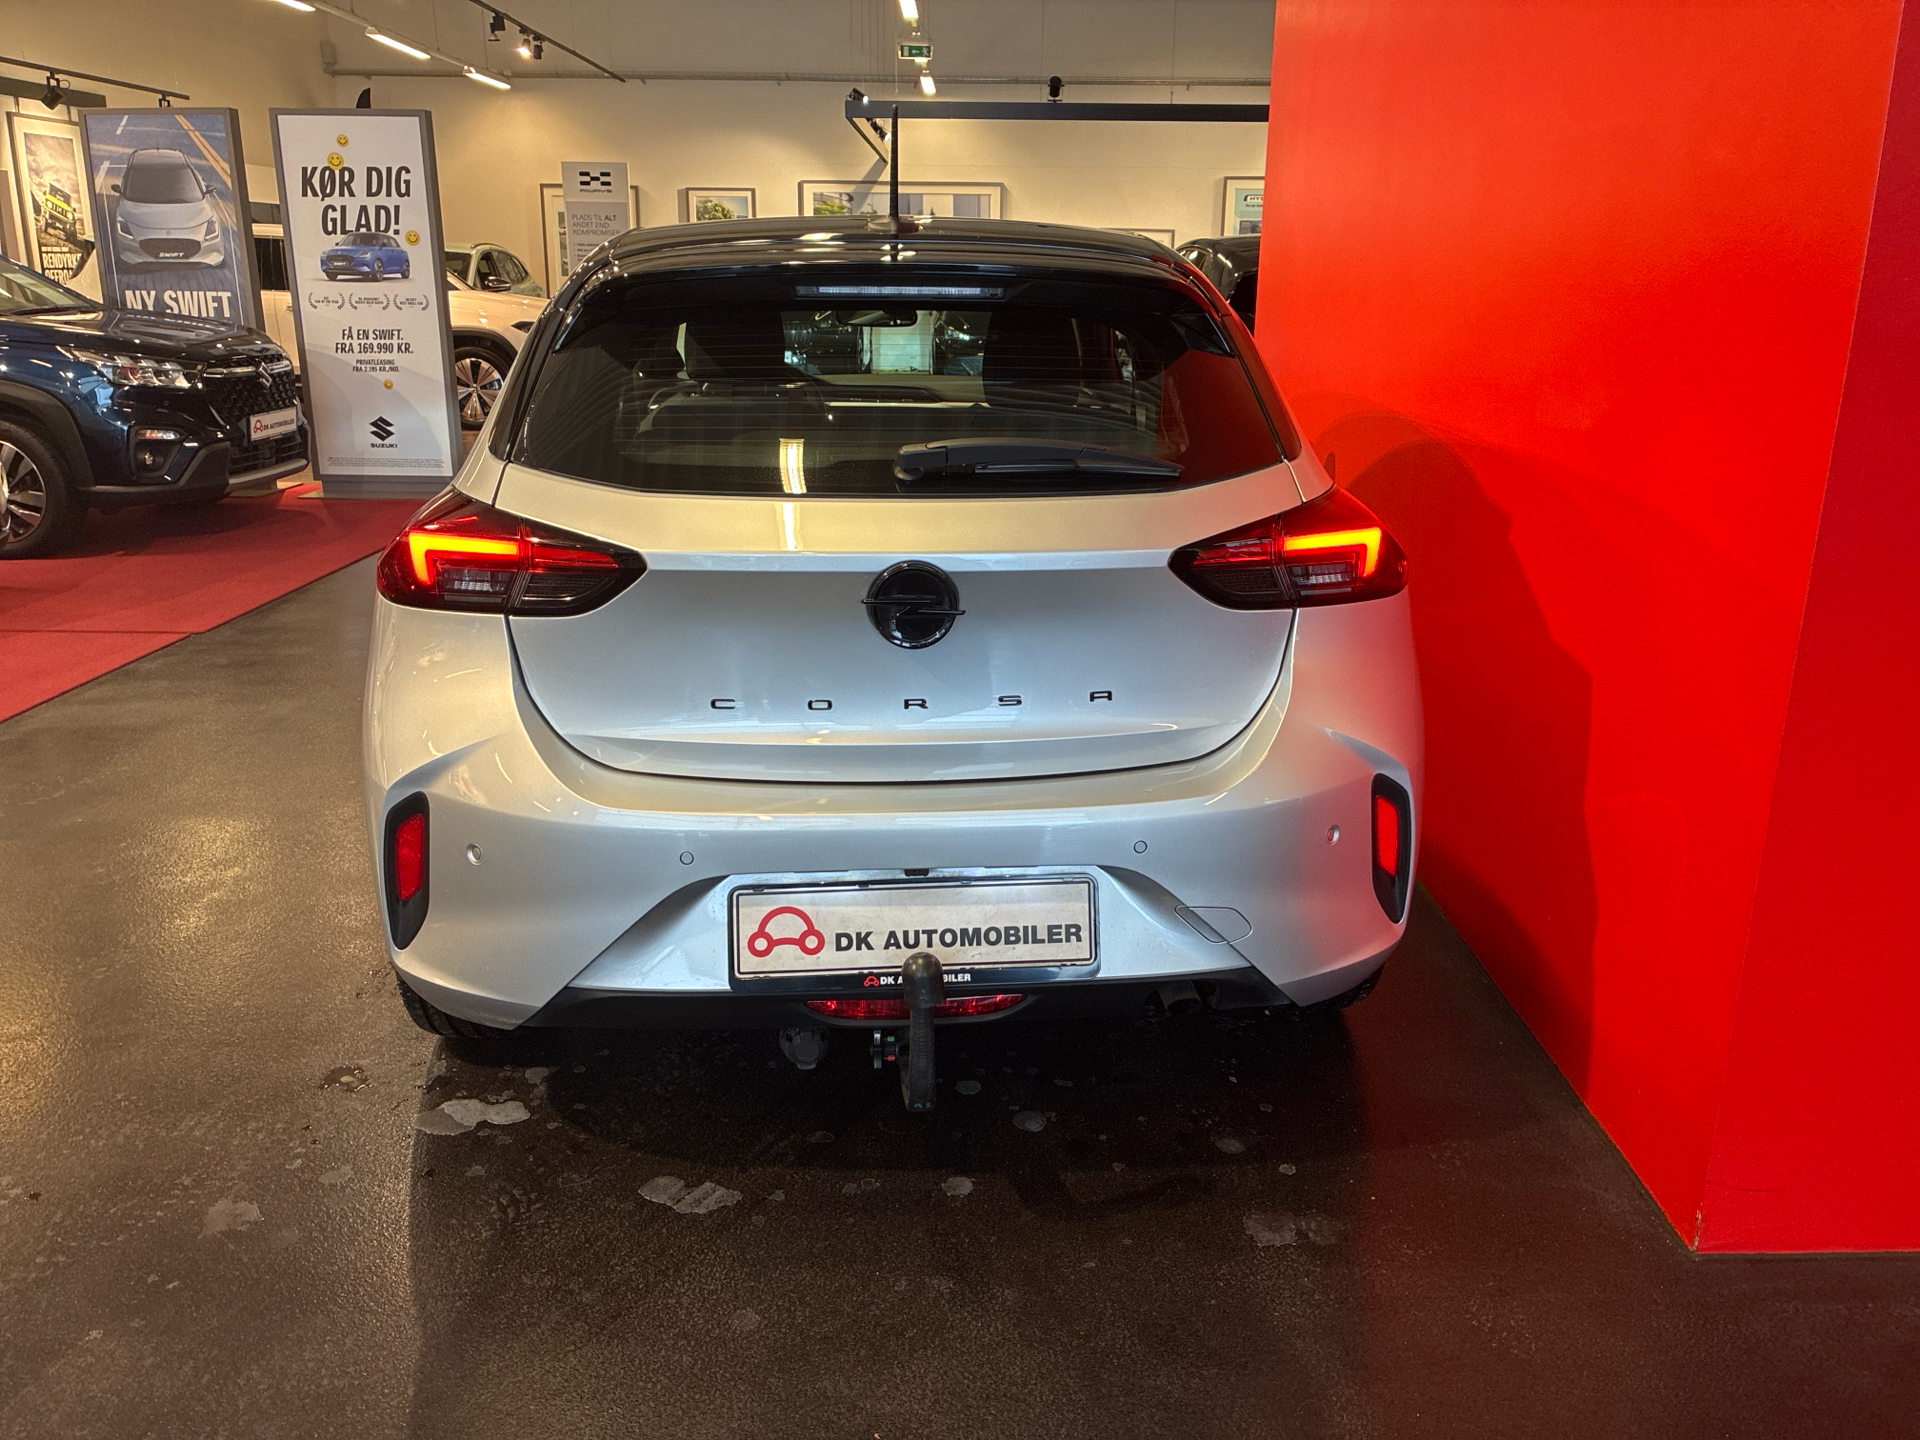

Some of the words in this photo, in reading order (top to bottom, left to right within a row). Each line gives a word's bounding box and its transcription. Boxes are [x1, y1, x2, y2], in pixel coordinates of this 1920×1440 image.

[301, 165, 356, 201] KØR
[365, 165, 411, 198] DIG
[321, 204, 400, 236] GLAD!
[125, 289, 156, 311] NY
[163, 289, 232, 318] SWIFT
[342, 326, 354, 340] FÅ
[357, 328, 370, 340] EN
[372, 328, 404, 341] SWIFT.
[335, 342, 354, 354] FRA
[357, 342, 394, 354] 169.990
[397, 342, 414, 354] KR.
[710, 689, 1113, 711] CORSA
[835, 931, 874, 952] DK
[883, 922, 1083, 951] AUTOMOBILER
[880, 975, 895, 985] DK
